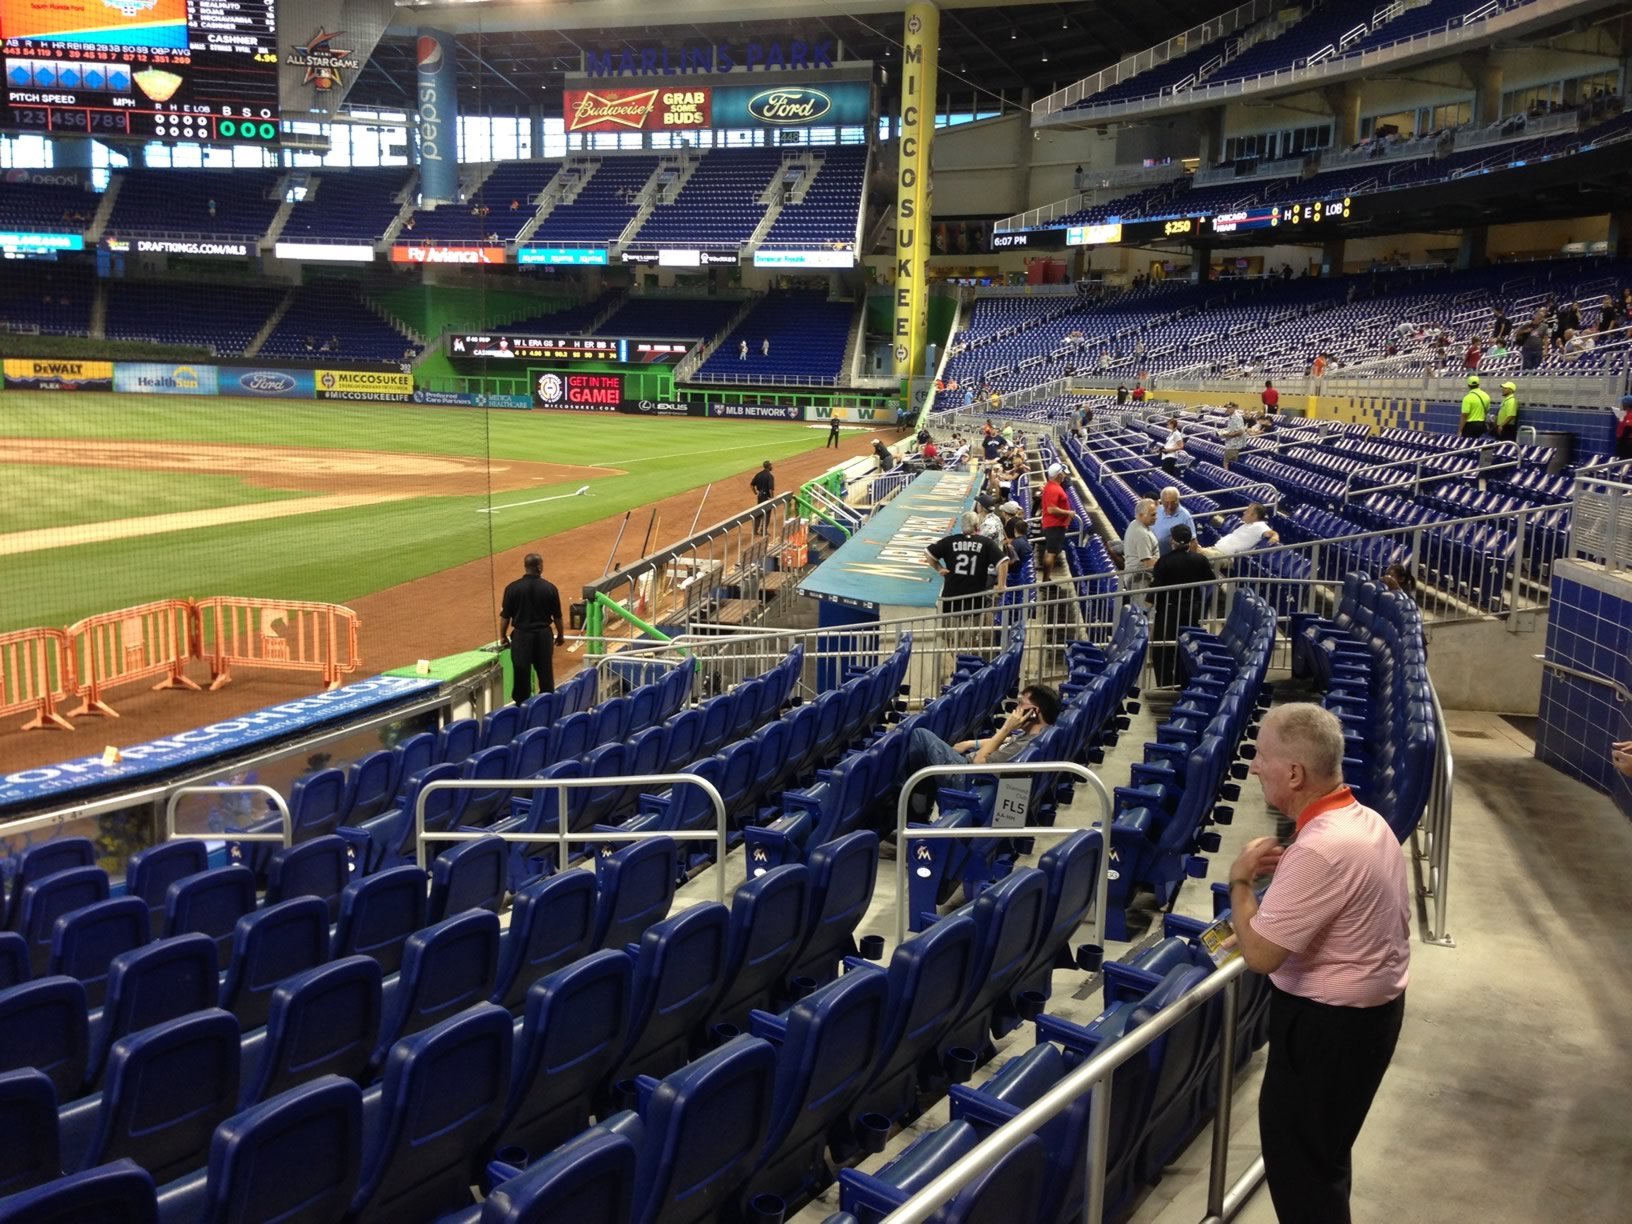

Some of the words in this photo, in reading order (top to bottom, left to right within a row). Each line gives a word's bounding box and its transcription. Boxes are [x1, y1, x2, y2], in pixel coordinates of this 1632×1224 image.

[208, 34, 258, 46] CASHNER
[83, 43, 96, 51] BB
[37, 48, 52, 56] 119
[69, 50, 80, 58] 39
[152, 55, 170, 63] .351
[286, 54, 305, 64] ALL
[306, 55, 330, 67] STAR
[330, 58, 358, 68] GAME
[587, 48, 738, 78] MARLINS
[746, 40, 834, 70] PARK
[9, 92, 40, 102] PITCH
[41, 94, 76, 104] SPEED
[113, 98, 136, 107] MPH
[663, 92, 704, 104] GRAB
[222, 106, 232, 116] B
[242, 108, 252, 117] S
[260, 108, 271, 118] O
[572, 98, 654, 118] Budweiser
[763, 94, 814, 118] Ford
[14, 110, 20, 122] 1
[23, 111, 33, 123] 2
[36, 112, 46, 124] 3
[52, 112, 62, 124] 4
[64, 113, 74, 126] 5
[76, 114, 86, 126] 6
[92, 114, 100, 126] 7
[104, 114, 114, 127] 8
[116, 116, 126, 128] 9
[155, 114, 165, 124] 0
[170, 114, 179, 124] 0
[183, 116, 192, 125] 0
[198, 116, 207, 126] 0
[419, 79, 442, 160] pepsi
[664, 112, 704, 124] BUDS
[156, 126, 166, 136] 0
[170, 126, 179, 136] 0
[184, 128, 193, 137] 0
[198, 128, 208, 138] 0
[220, 121, 236, 136] 0
[240, 122, 256, 138] 0
[260, 124, 275, 139] 0
[781, 132, 799, 142] 448
[895, 44, 922, 337] MICCOSUKEE
[1284, 210, 1292, 220] H
[1304, 208, 1312, 218] E
[1326, 203, 1342, 216] LOB
[1217, 212, 1247, 222] CHICAGO
[1164, 220, 1191, 236] $250
[1216, 224, 1236, 232] MIAMI
[994, 236, 1012, 246] 6:07
[1014, 236, 1026, 245] PM
[138, 240, 246, 255] DRAFTKINGS.COM/MLB
[408, 248, 426, 262] Fly
[428, 248, 478, 262] Avianca
[138, 377, 198, 388] HealthSun
[250, 375, 284, 390] Ford
[339, 374, 408, 384] MICCOSUKEE
[569, 376, 587, 386] GET
[590, 377, 599, 386] IN
[600, 377, 620, 388] THE
[325, 392, 408, 401] #MICCOSUKEELIFE
[569, 388, 620, 404] GAME!
[726, 406, 744, 415] MLB
[745, 407, 786, 417] NETWORK
[952, 541, 983, 552] COOPER
[955, 554, 978, 576] 21
[120, 711, 288, 759] RICOH
[271, 676, 405, 713] RICOH
